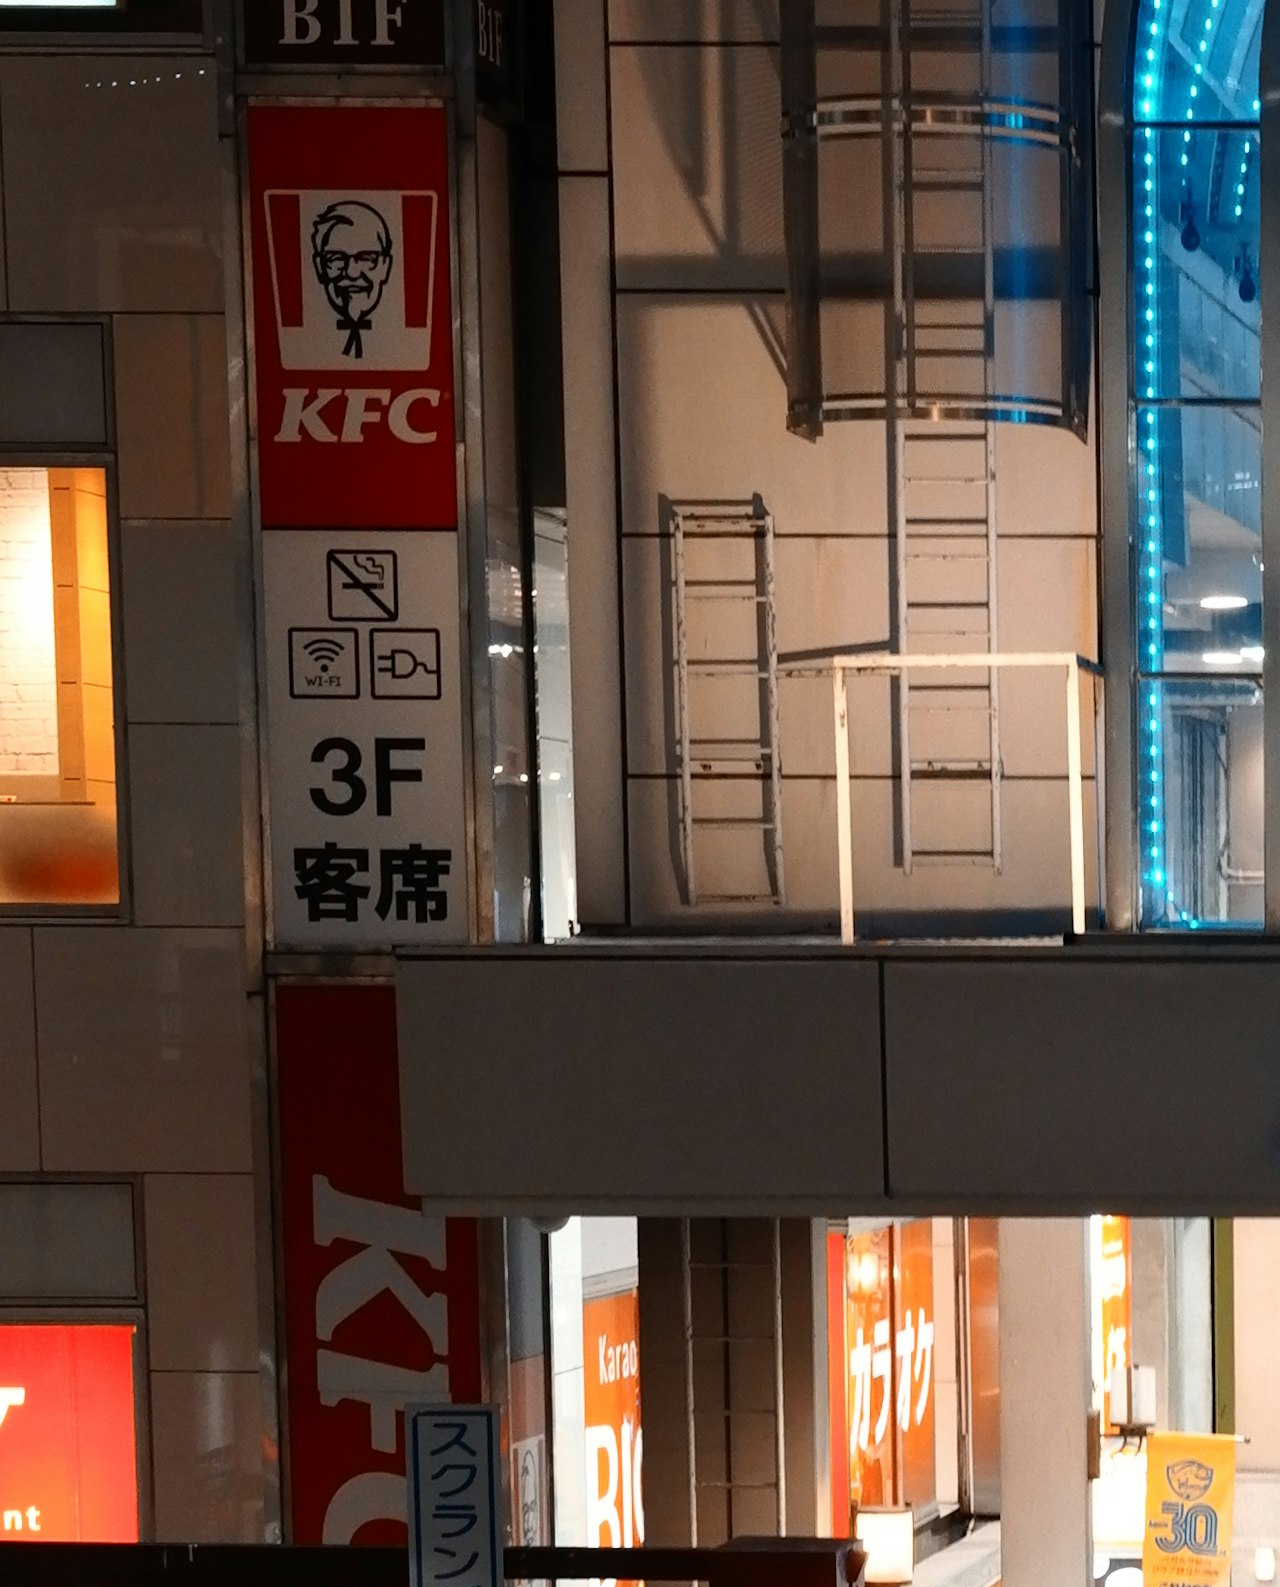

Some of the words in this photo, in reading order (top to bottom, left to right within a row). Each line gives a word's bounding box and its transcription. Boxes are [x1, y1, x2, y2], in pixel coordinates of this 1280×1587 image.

[273, 388, 441, 444] KFC
[305, 675, 342, 687] WI-FI
[308, 737, 426, 817] 3F
[293, 842, 452, 924] 客席
[850, 1306, 934, 1457] カラオケ
[1154, 1501, 1219, 1557] 30
